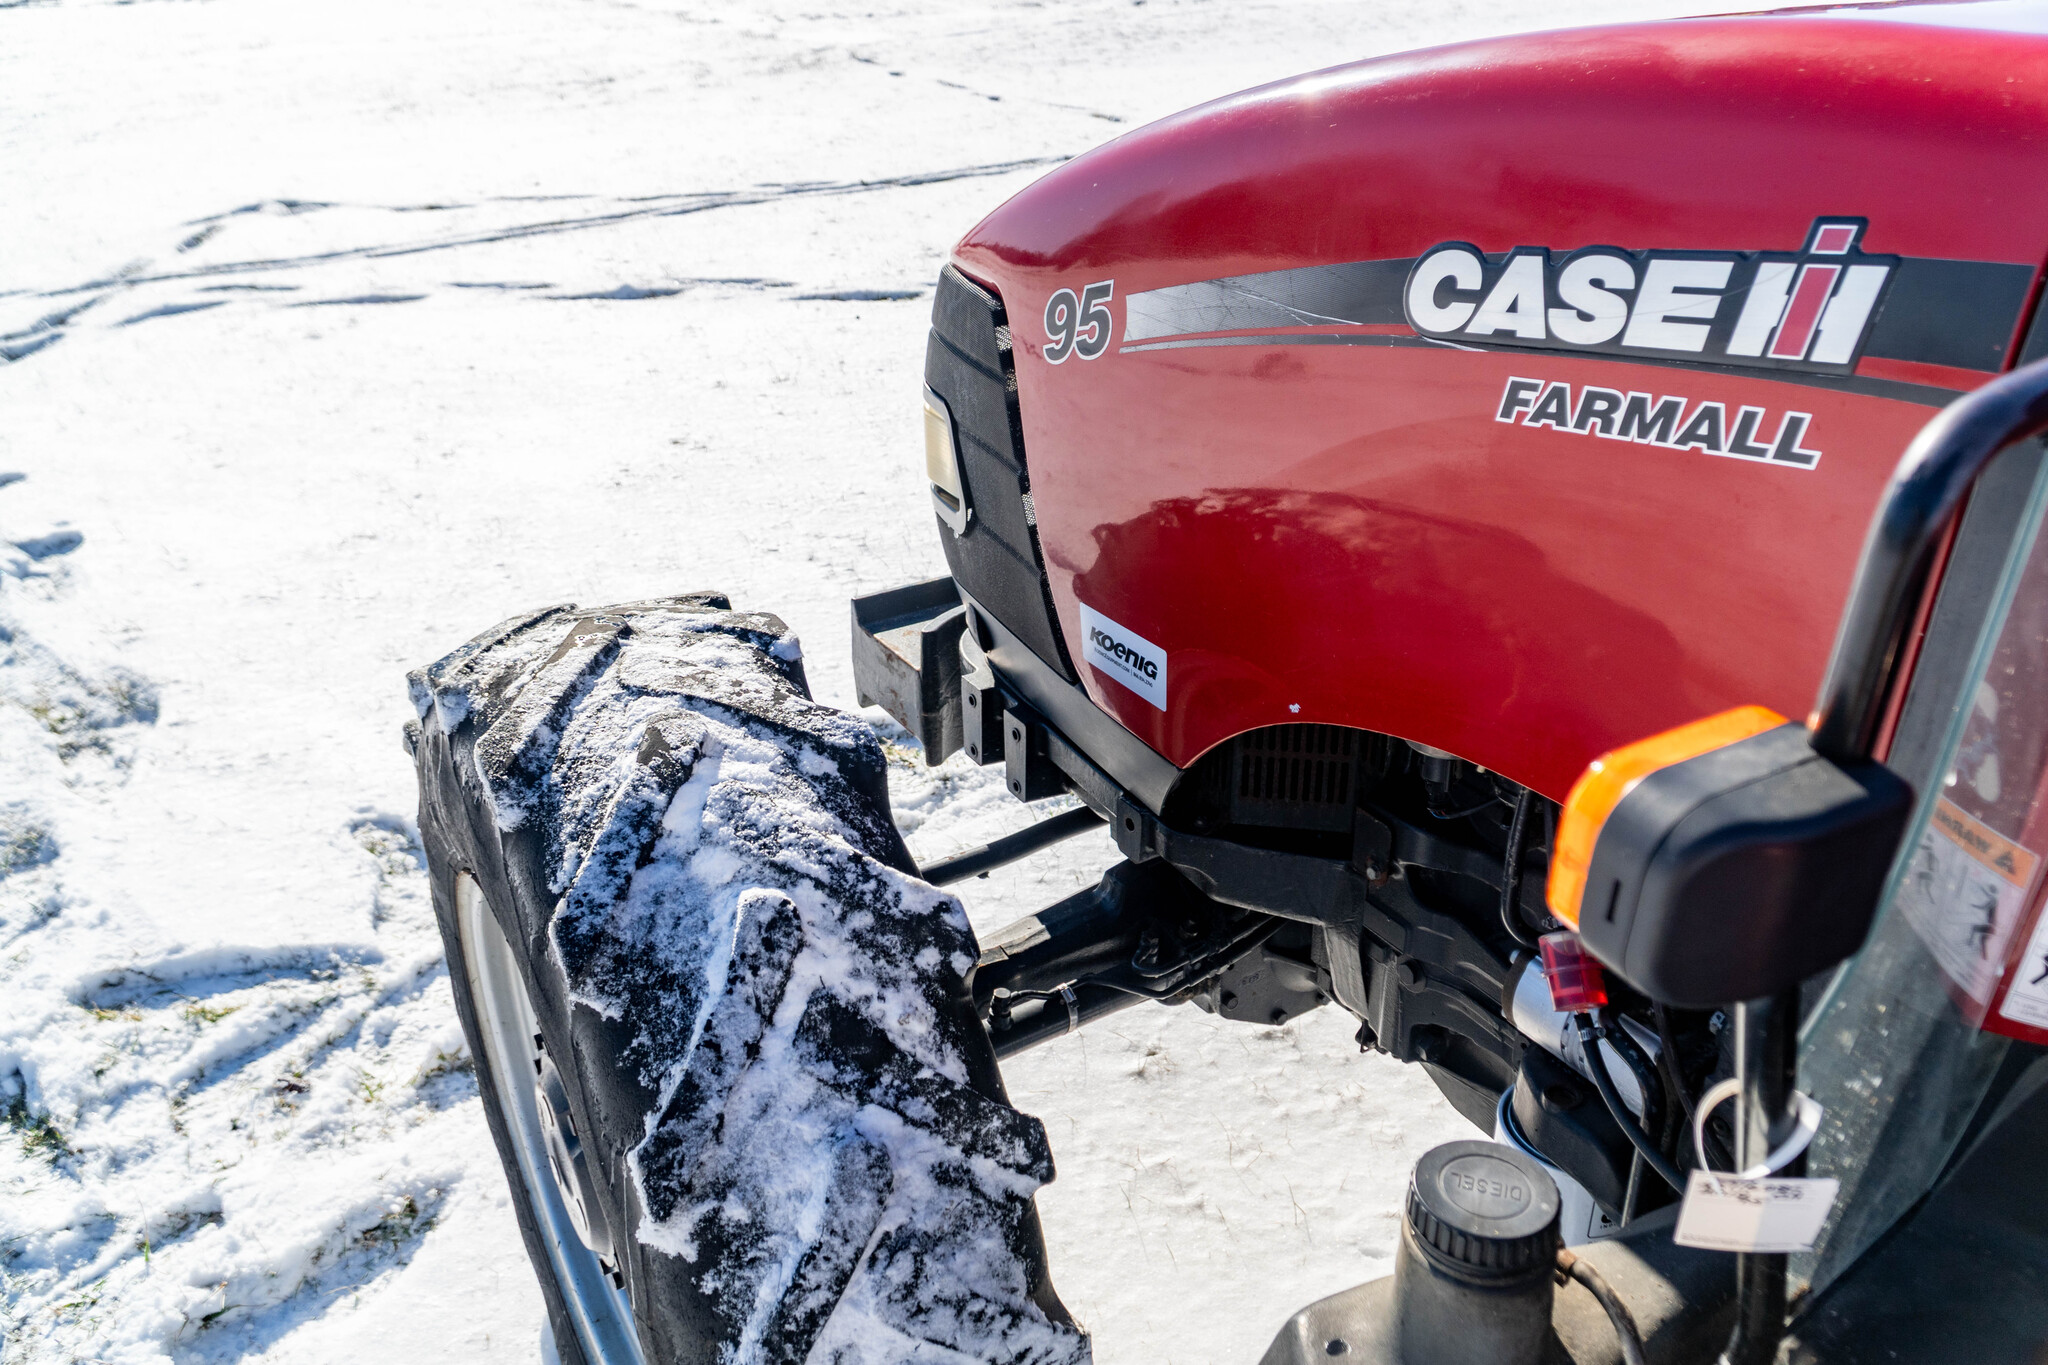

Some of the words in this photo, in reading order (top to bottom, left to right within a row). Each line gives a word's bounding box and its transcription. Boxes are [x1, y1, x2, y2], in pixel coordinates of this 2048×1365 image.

[1043, 279, 1115, 365] 95
[1408, 248, 1735, 351] CASE
[1496, 376, 1823, 470] FARMALL
[1450, 1171, 1523, 1202] DIESEL
